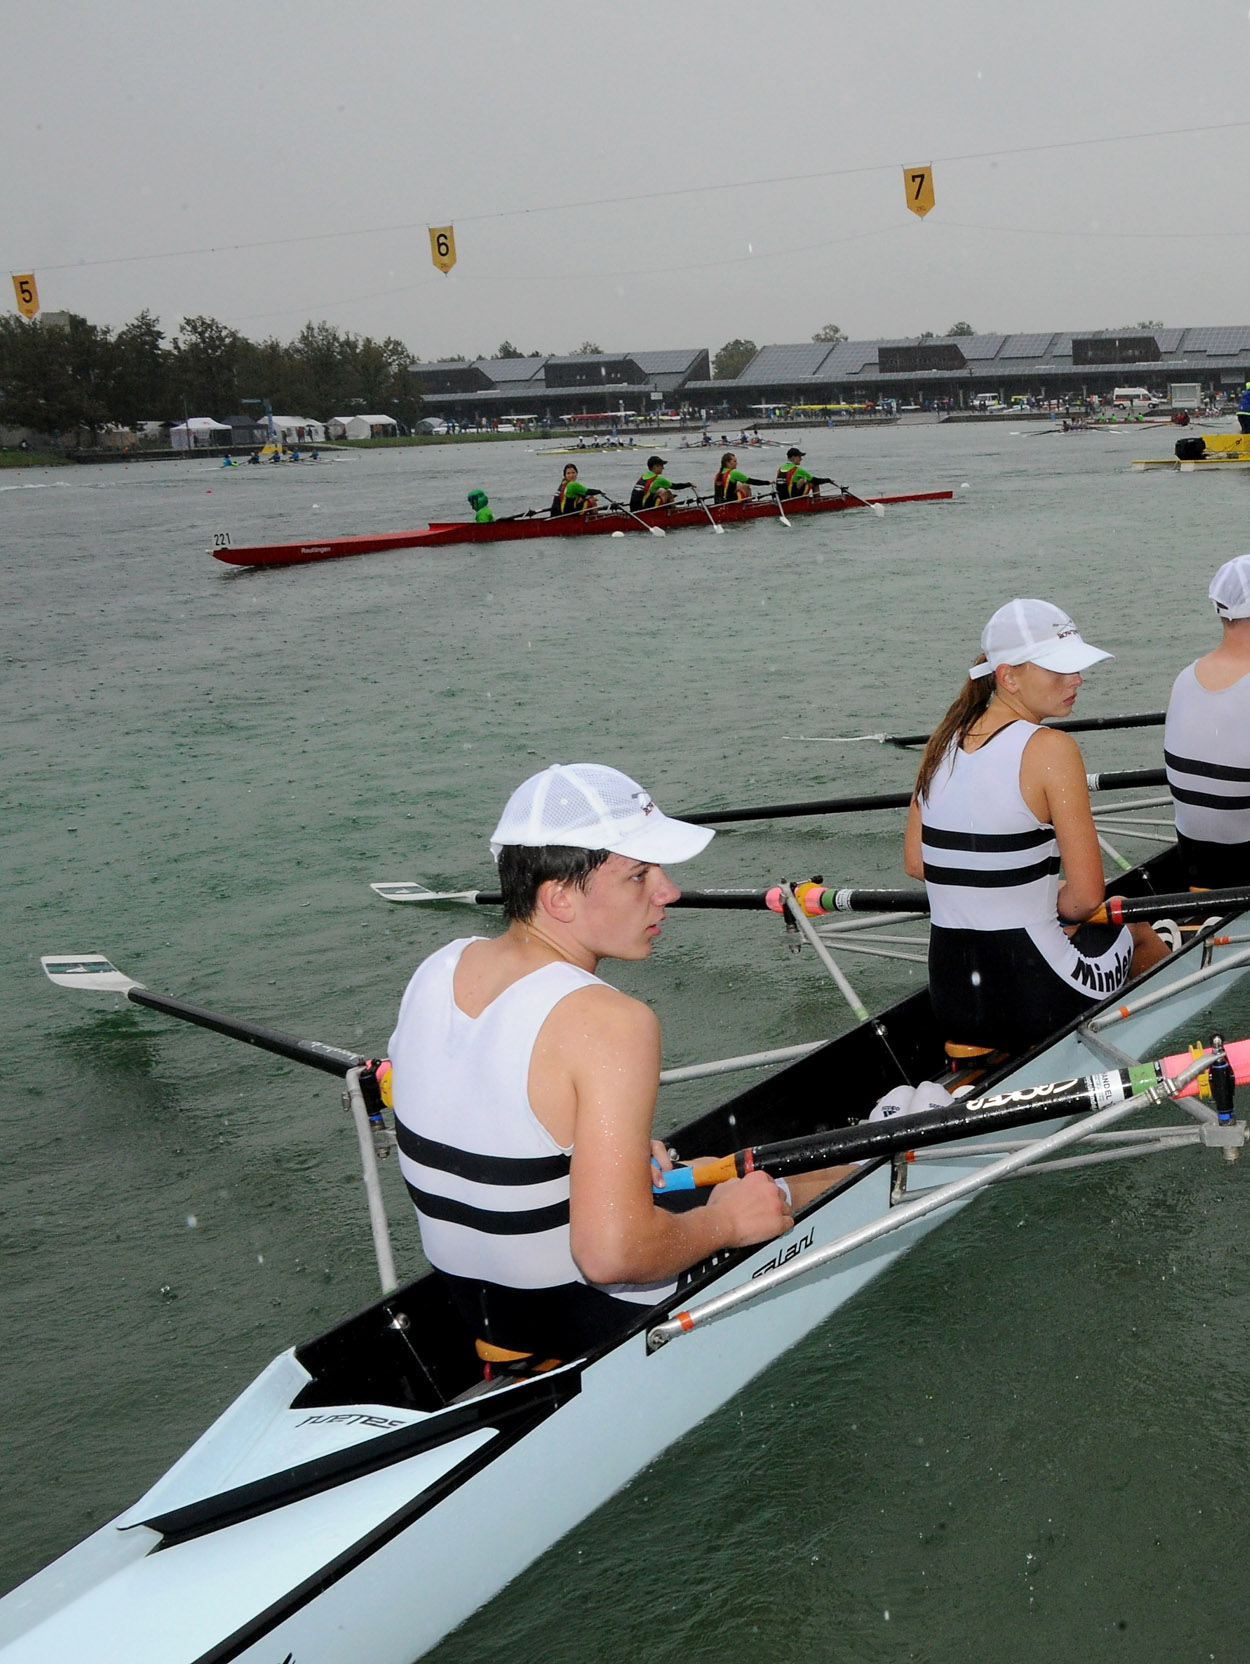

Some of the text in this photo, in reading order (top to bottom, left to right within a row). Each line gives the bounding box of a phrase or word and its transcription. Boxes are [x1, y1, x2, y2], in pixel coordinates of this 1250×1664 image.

[911, 174, 925, 200] 7
[436, 233, 449, 257] 6
[19, 280, 33, 303] 5
[214, 533, 231, 546] 221
